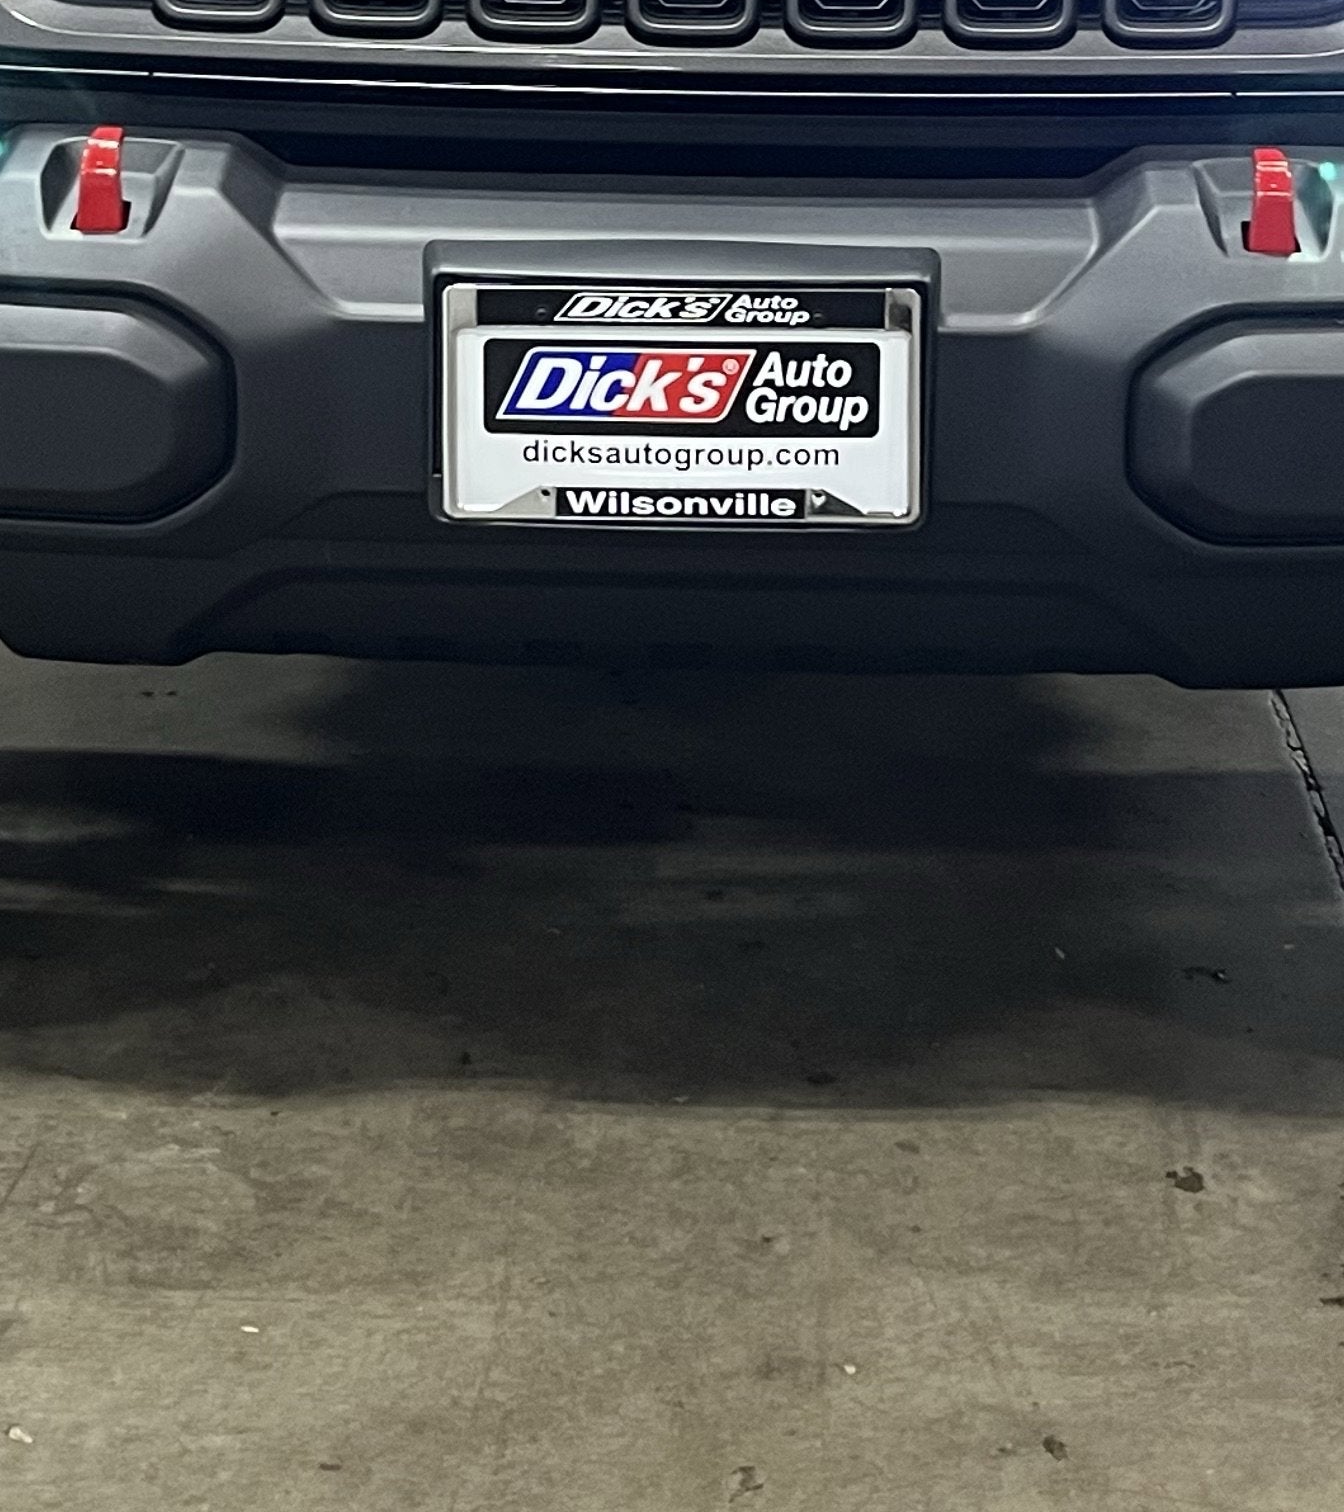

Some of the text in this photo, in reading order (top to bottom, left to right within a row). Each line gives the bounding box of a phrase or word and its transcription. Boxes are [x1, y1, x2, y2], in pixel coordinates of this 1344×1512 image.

[567, 296, 712, 318] Dick's
[731, 294, 799, 309] Auto
[724, 308, 810, 326] Group
[515, 355, 729, 413] Dick's
[752, 352, 852, 388] Auto
[745, 392, 869, 431] Group
[523, 440, 840, 472] dicksautogroup.com
[566, 490, 796, 517] Wilsonville
